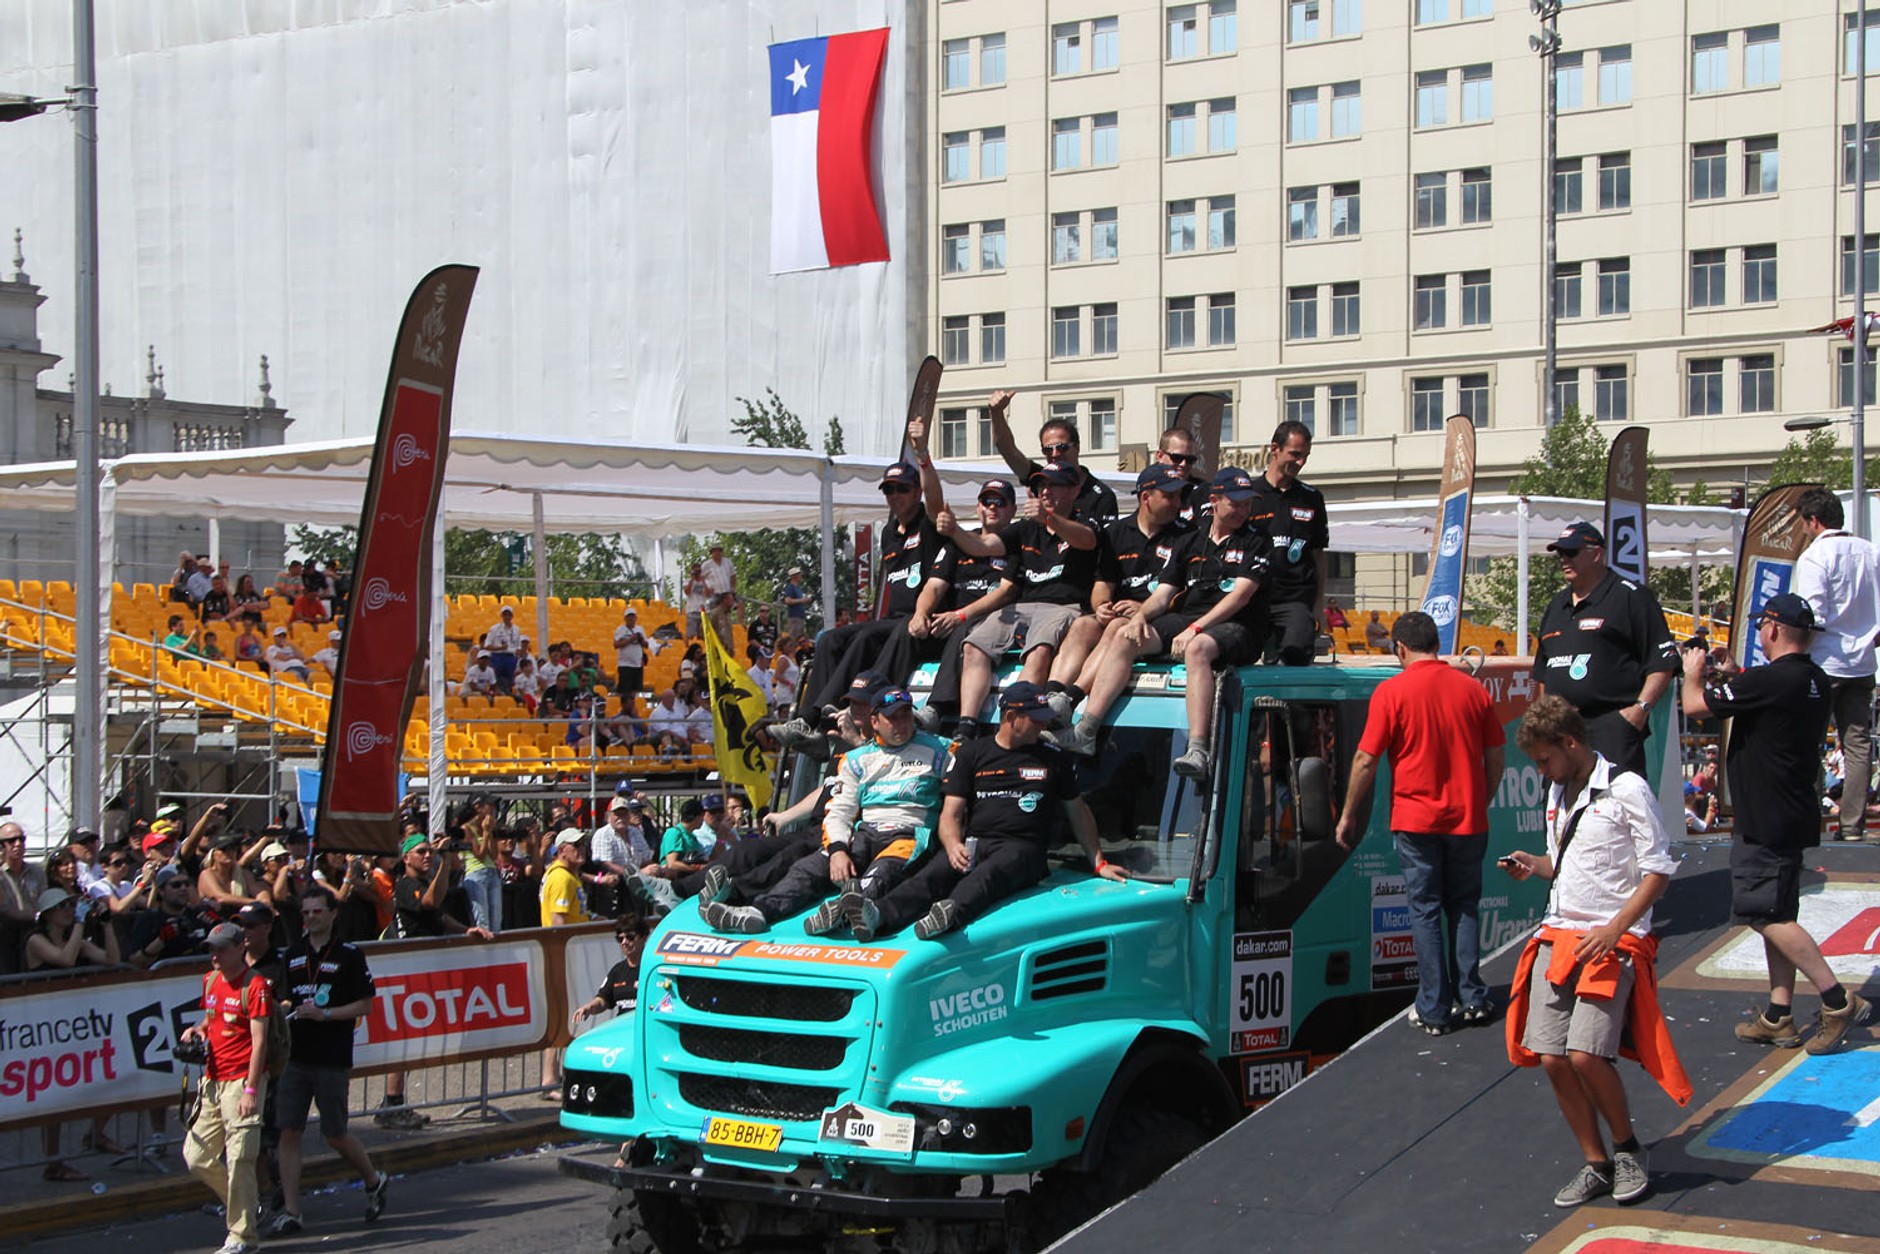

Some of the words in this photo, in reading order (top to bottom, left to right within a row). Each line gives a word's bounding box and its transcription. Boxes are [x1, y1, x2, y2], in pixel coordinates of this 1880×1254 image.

[1432, 600, 1451, 614] FOX
[663, 934, 741, 954] FERM
[754, 944, 821, 957] POWER
[824, 949, 884, 962] TOOLS
[1236, 939, 1289, 955] dakar.com
[375, 983, 524, 1032] TOTAL
[929, 983, 1004, 1021] IVECO
[1239, 970, 1285, 1022] 500
[0, 1008, 113, 1050] francetv
[933, 1005, 1008, 1037] SCHOUTEN
[1244, 1034, 1278, 1047] TOTAL
[0, 1038, 117, 1102] sport
[1248, 1061, 1303, 1096] FERM
[710, 1121, 780, 1147] 85-BBH-7
[850, 1122, 874, 1138] 500
